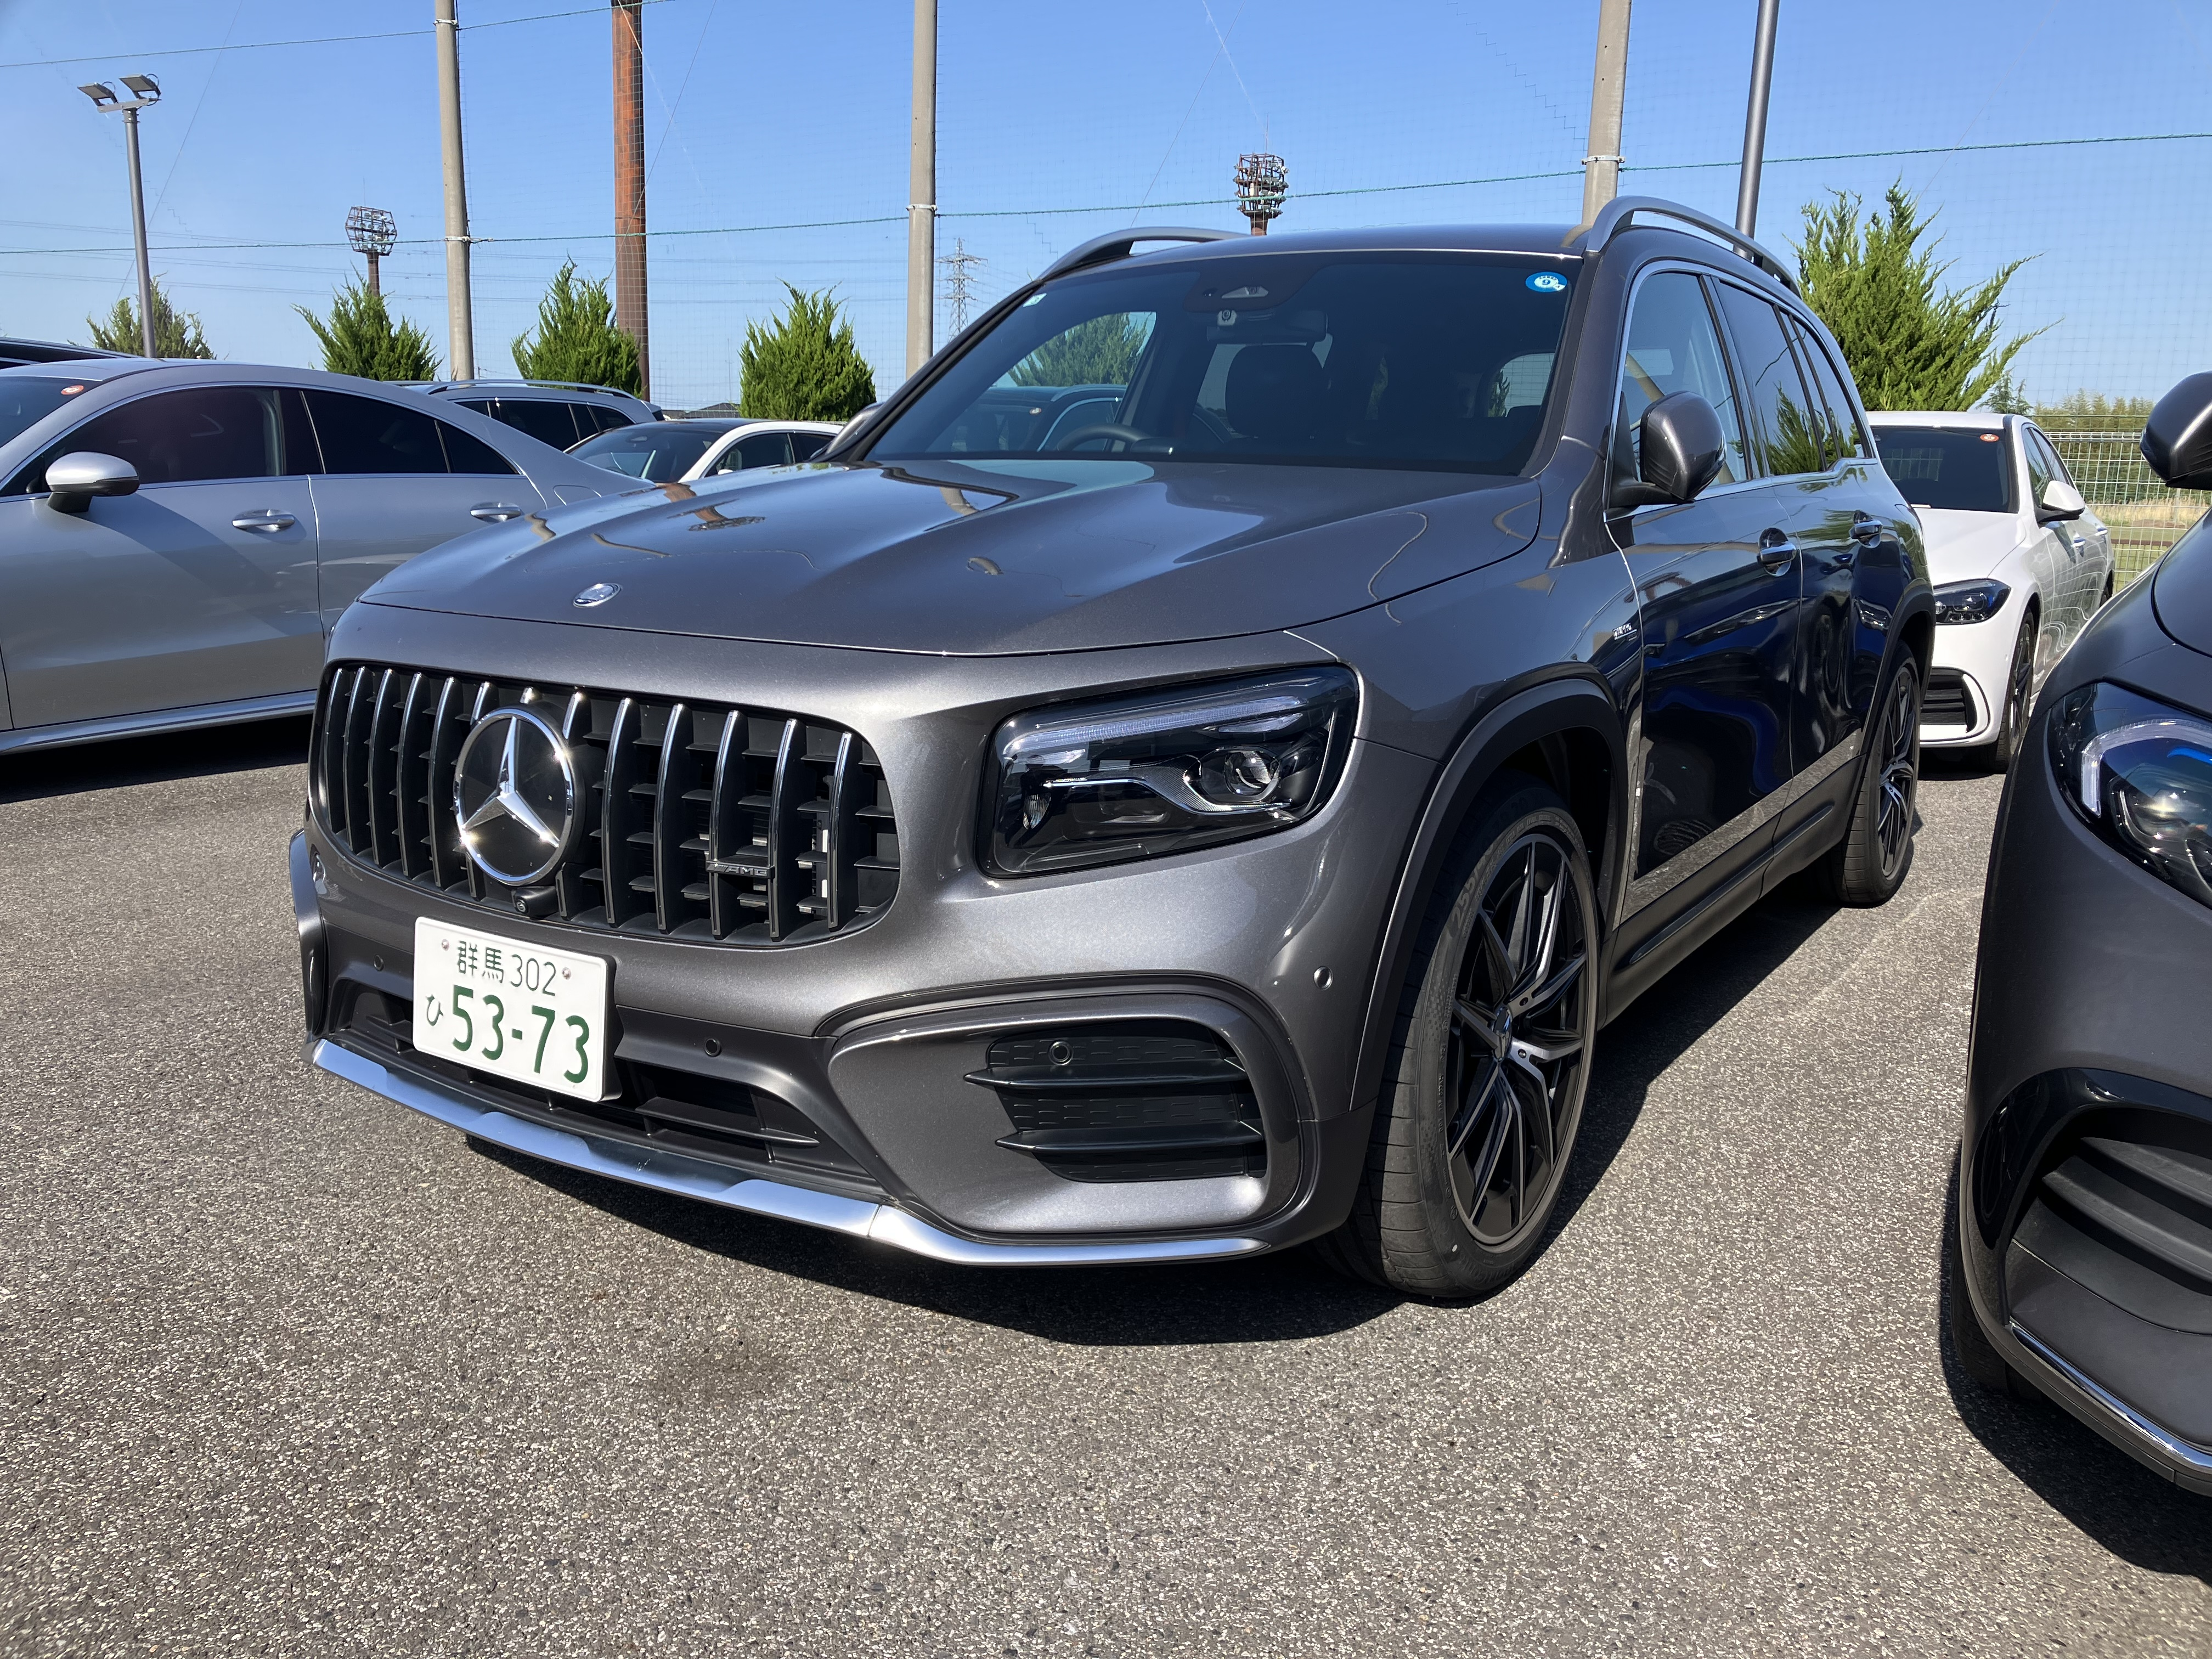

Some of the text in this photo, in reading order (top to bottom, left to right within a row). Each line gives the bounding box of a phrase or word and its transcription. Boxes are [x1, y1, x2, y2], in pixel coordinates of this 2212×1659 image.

[725, 865, 768, 877] AMG
[456, 940, 556, 996] 群馬 302
[425, 984, 590, 1084] ひ 53-73
